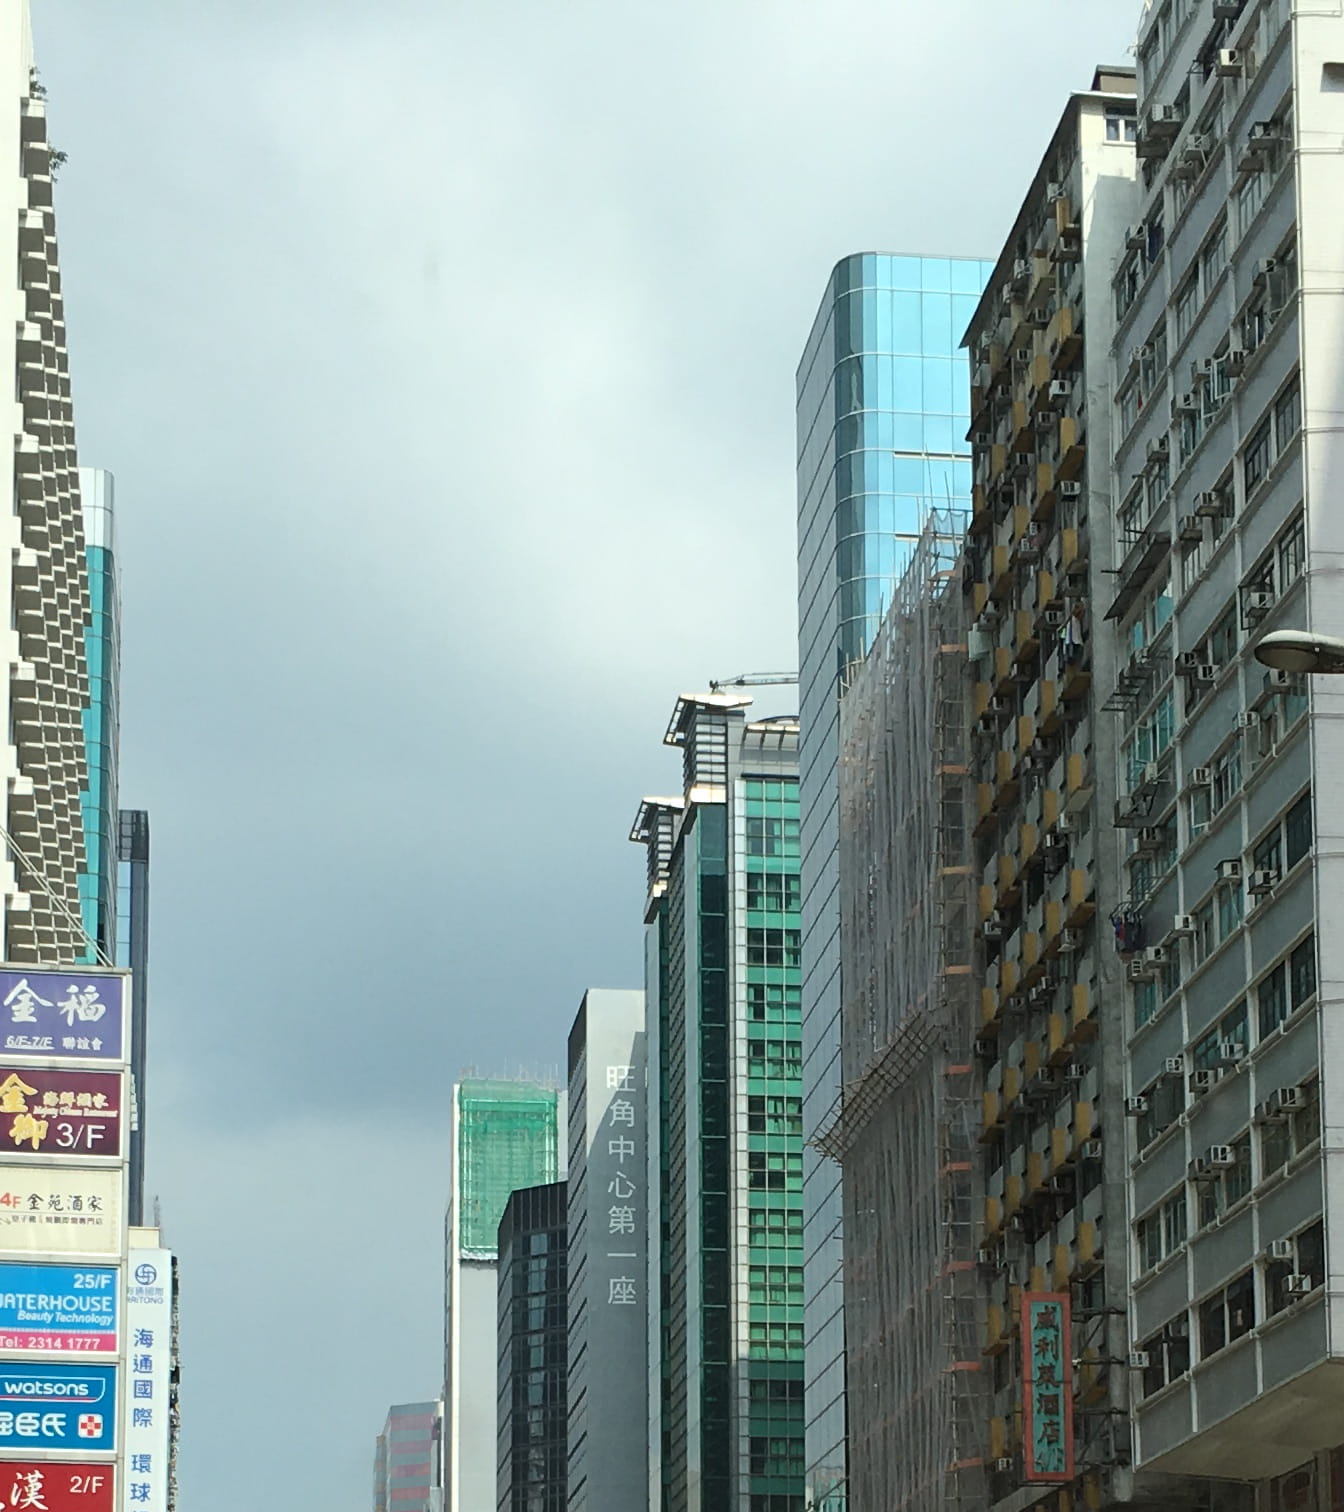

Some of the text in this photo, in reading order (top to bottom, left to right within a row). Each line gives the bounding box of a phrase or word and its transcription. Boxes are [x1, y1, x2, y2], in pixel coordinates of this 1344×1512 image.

[4, 978, 107, 1026] 金福
[56, 1123, 105, 1149] 3/F
[606, 1064, 637, 1306] 旺角中心第一座
[0, 1192, 103, 1211] 4F 金苑酒家
[74, 1274, 112, 1288] 25/F
[18, 1311, 113, 1325] Beauty Technology
[28, 1336, 63, 1349] 2314
[68, 1337, 100, 1350] 1777
[133, 1329, 154, 1428] 海通國際
[5, 1380, 89, 1396] watsons
[70, 1476, 104, 1493] 2/F
